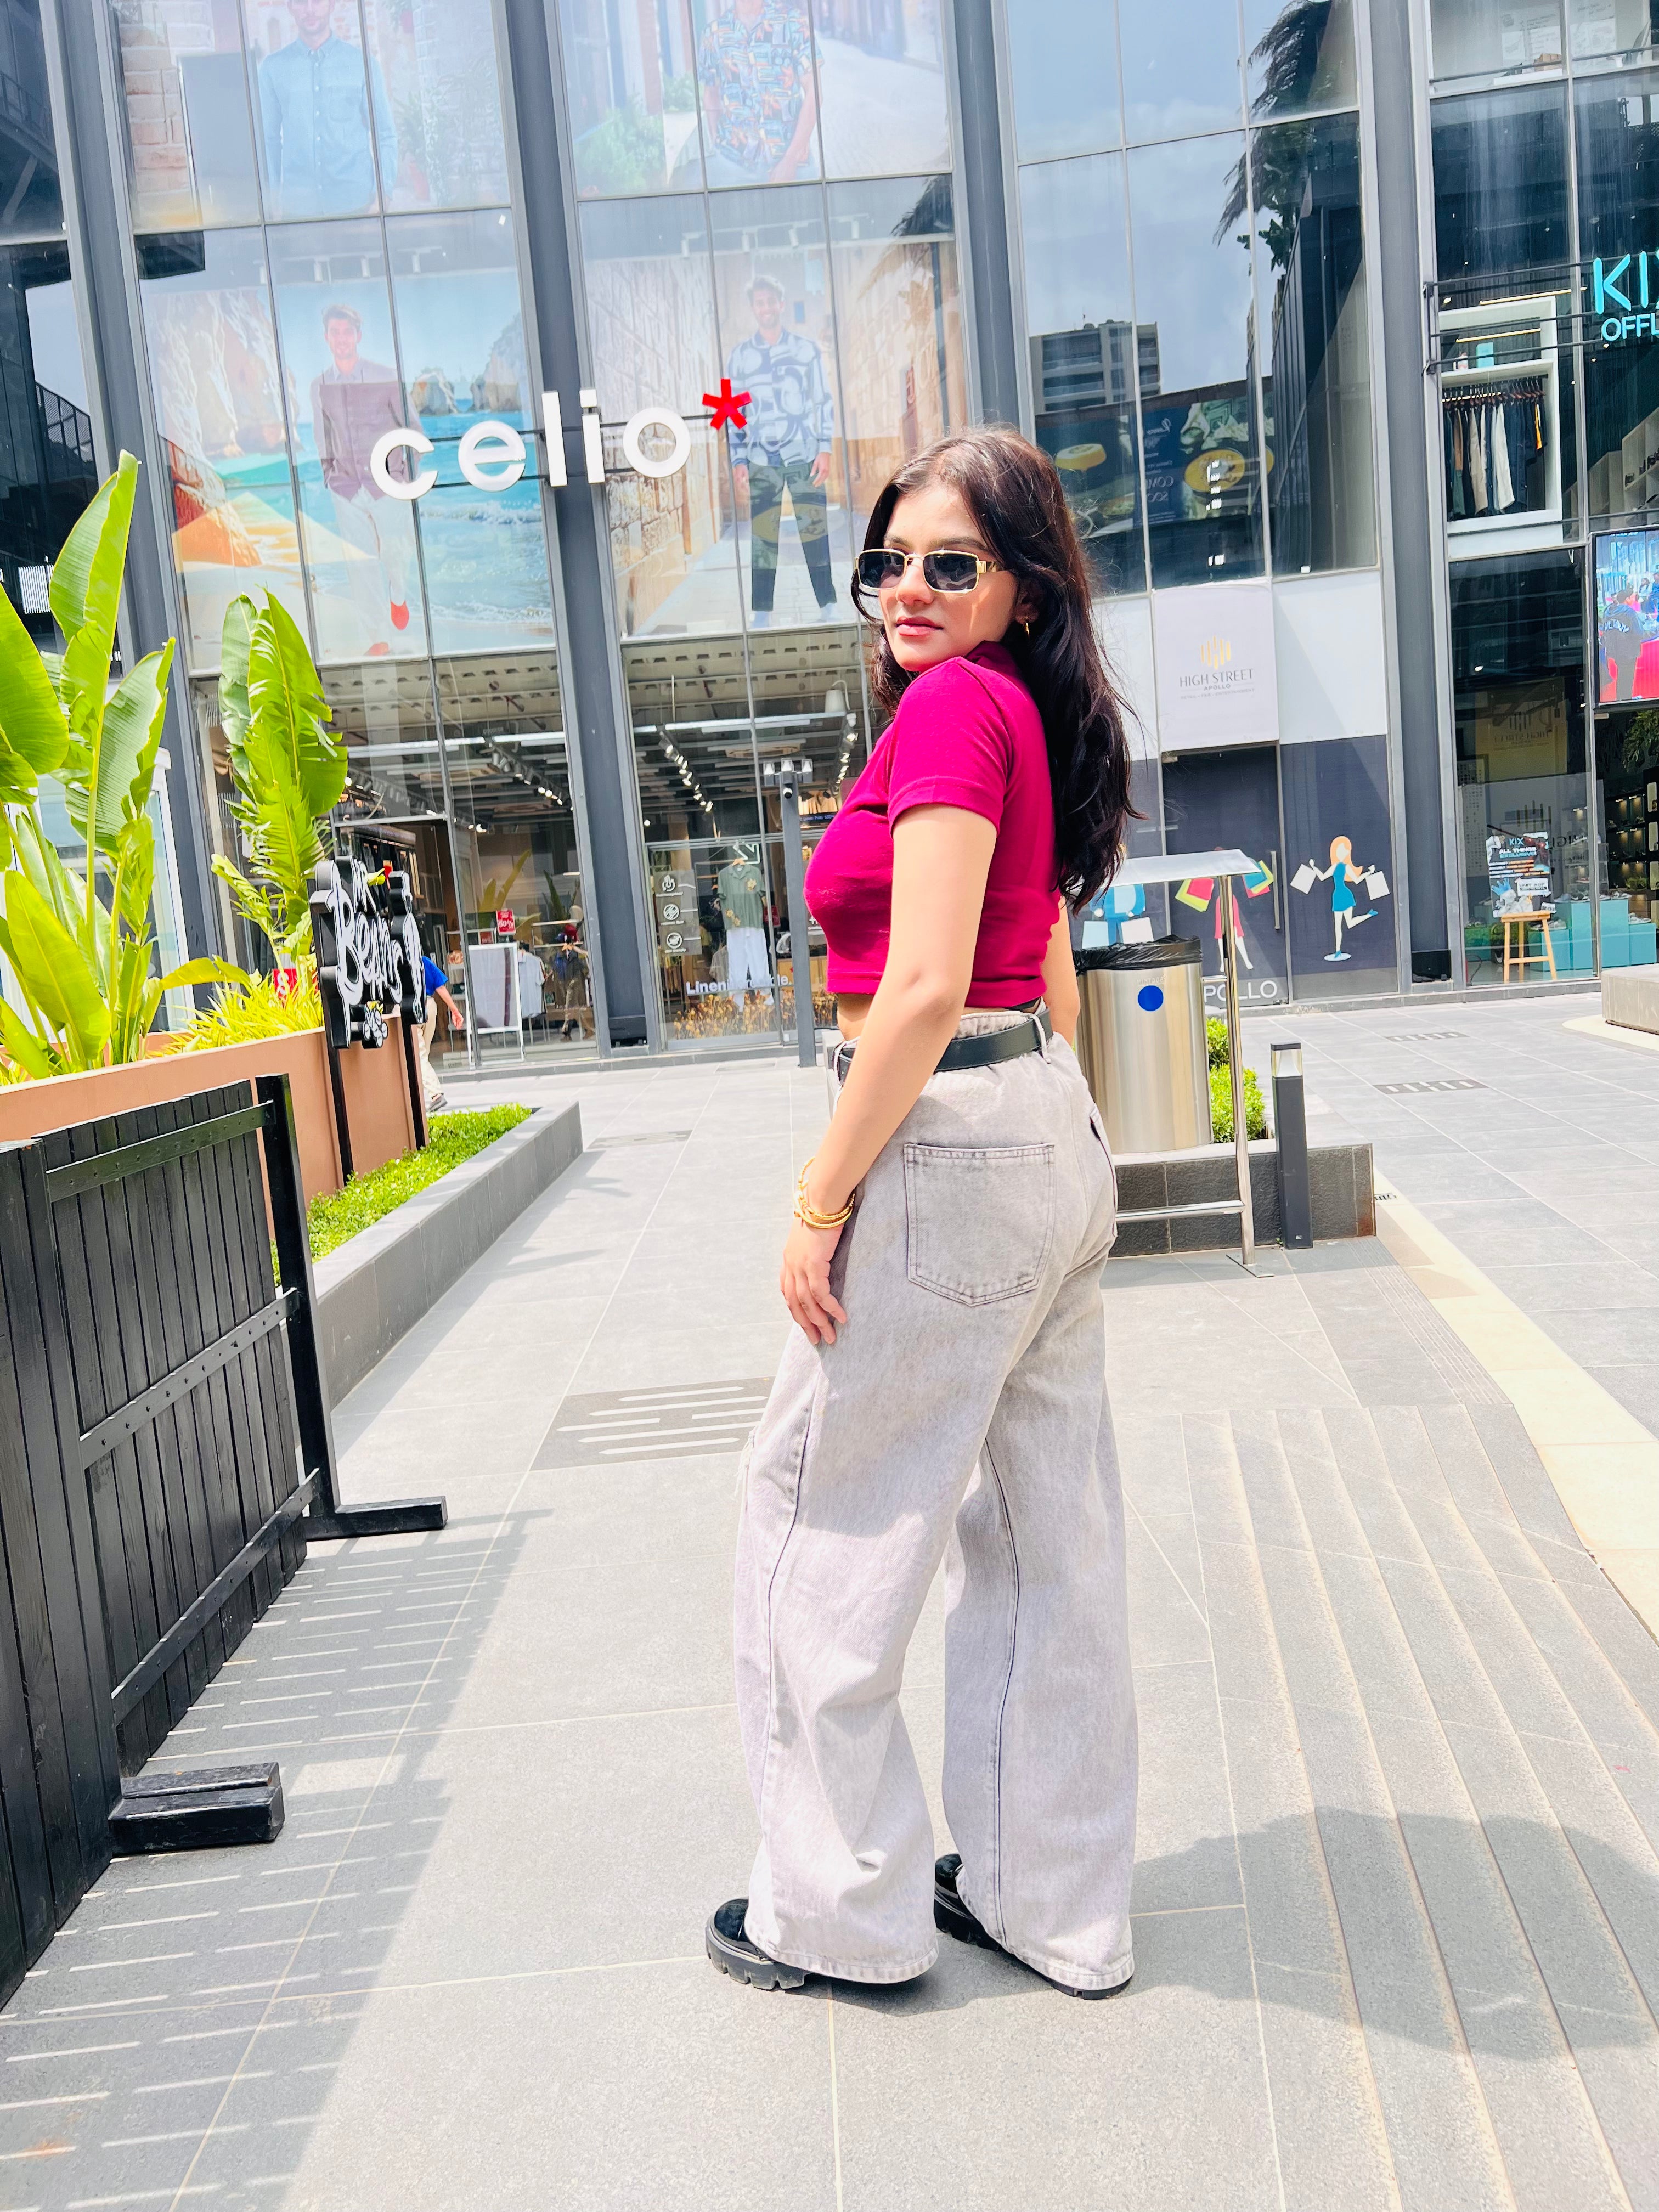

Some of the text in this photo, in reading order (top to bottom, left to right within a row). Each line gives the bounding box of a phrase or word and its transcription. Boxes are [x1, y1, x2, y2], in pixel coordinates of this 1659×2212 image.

[1593, 249, 1659, 314] KI
[370, 388, 692, 500] celio
[1180, 668, 1254, 688] HIGH STREET
[1509, 838, 1524, 846] KIX
